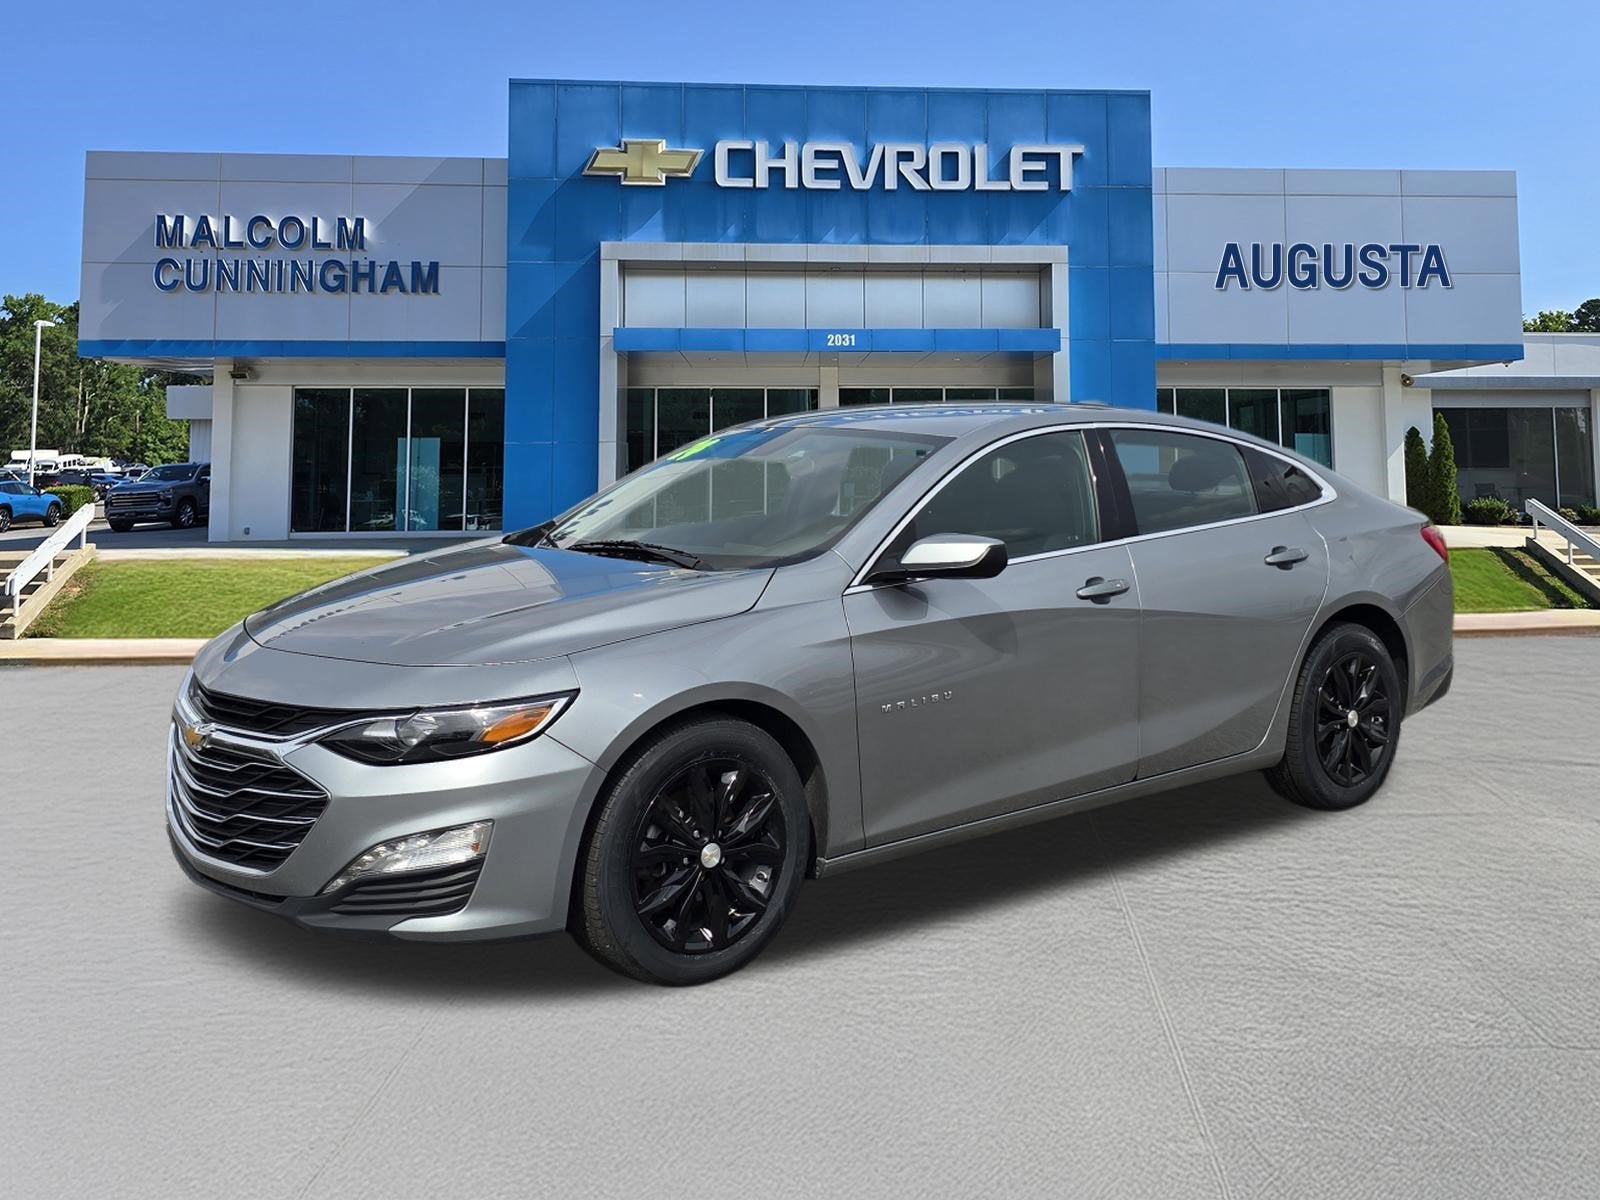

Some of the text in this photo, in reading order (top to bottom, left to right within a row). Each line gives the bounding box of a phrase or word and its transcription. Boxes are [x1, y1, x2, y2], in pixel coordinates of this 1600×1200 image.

[714, 139, 1085, 191] CHEVROLET
[155, 215, 366, 251] MALCOLM
[153, 257, 440, 294] CUNNINGHAM
[1214, 242, 1452, 290] AUGUSTA
[827, 334, 855, 346] 2031
[881, 690, 953, 713] MALIBU
